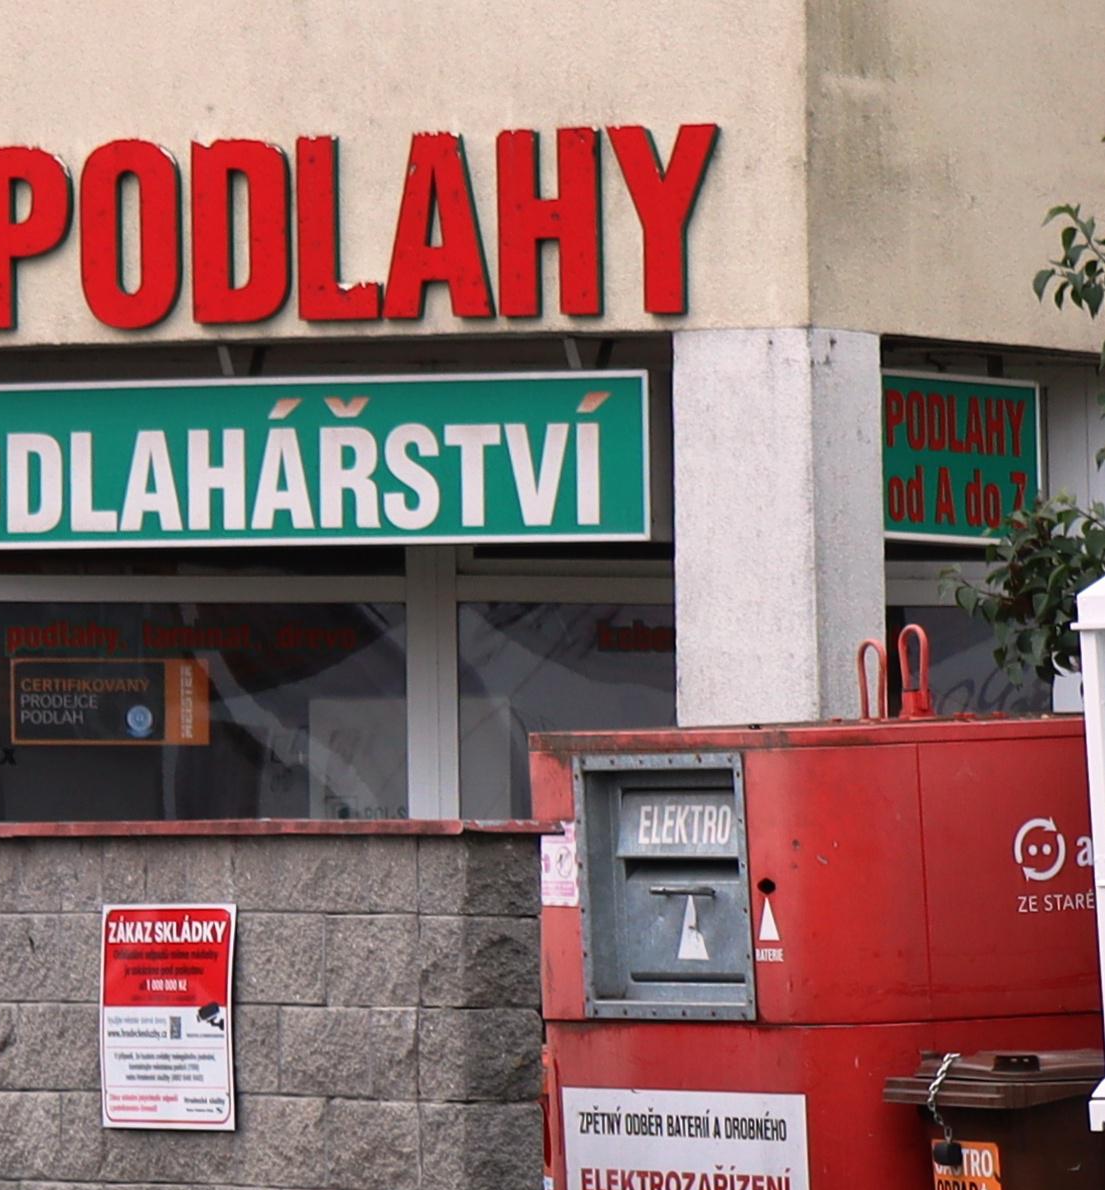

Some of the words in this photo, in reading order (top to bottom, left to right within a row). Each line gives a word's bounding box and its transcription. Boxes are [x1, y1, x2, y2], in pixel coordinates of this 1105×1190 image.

[885, 388, 1025, 458] PODLAHY
[888, 464, 925, 524] od
[935, 466, 956, 525] A
[965, 468, 1001, 529] do
[20, 694, 99, 709] PRODEJCE
[20, 710, 85, 725] PODLAH
[638, 804, 732, 845] ELEKTRO
[1017, 896, 1039, 913] ZE
[108, 915, 152, 944] ZÁKAZ
[154, 914, 227, 943] SKLÁDKY
[579, 1105, 622, 1135] ZPĚTNÝ
[624, 1107, 663, 1137] ODBĚR
[666, 1109, 710, 1138] BATERIÍ
[713, 1117, 722, 1139] A
[724, 1111, 787, 1141] DROBNÉHO
[935, 1148, 994, 1178] TRO
